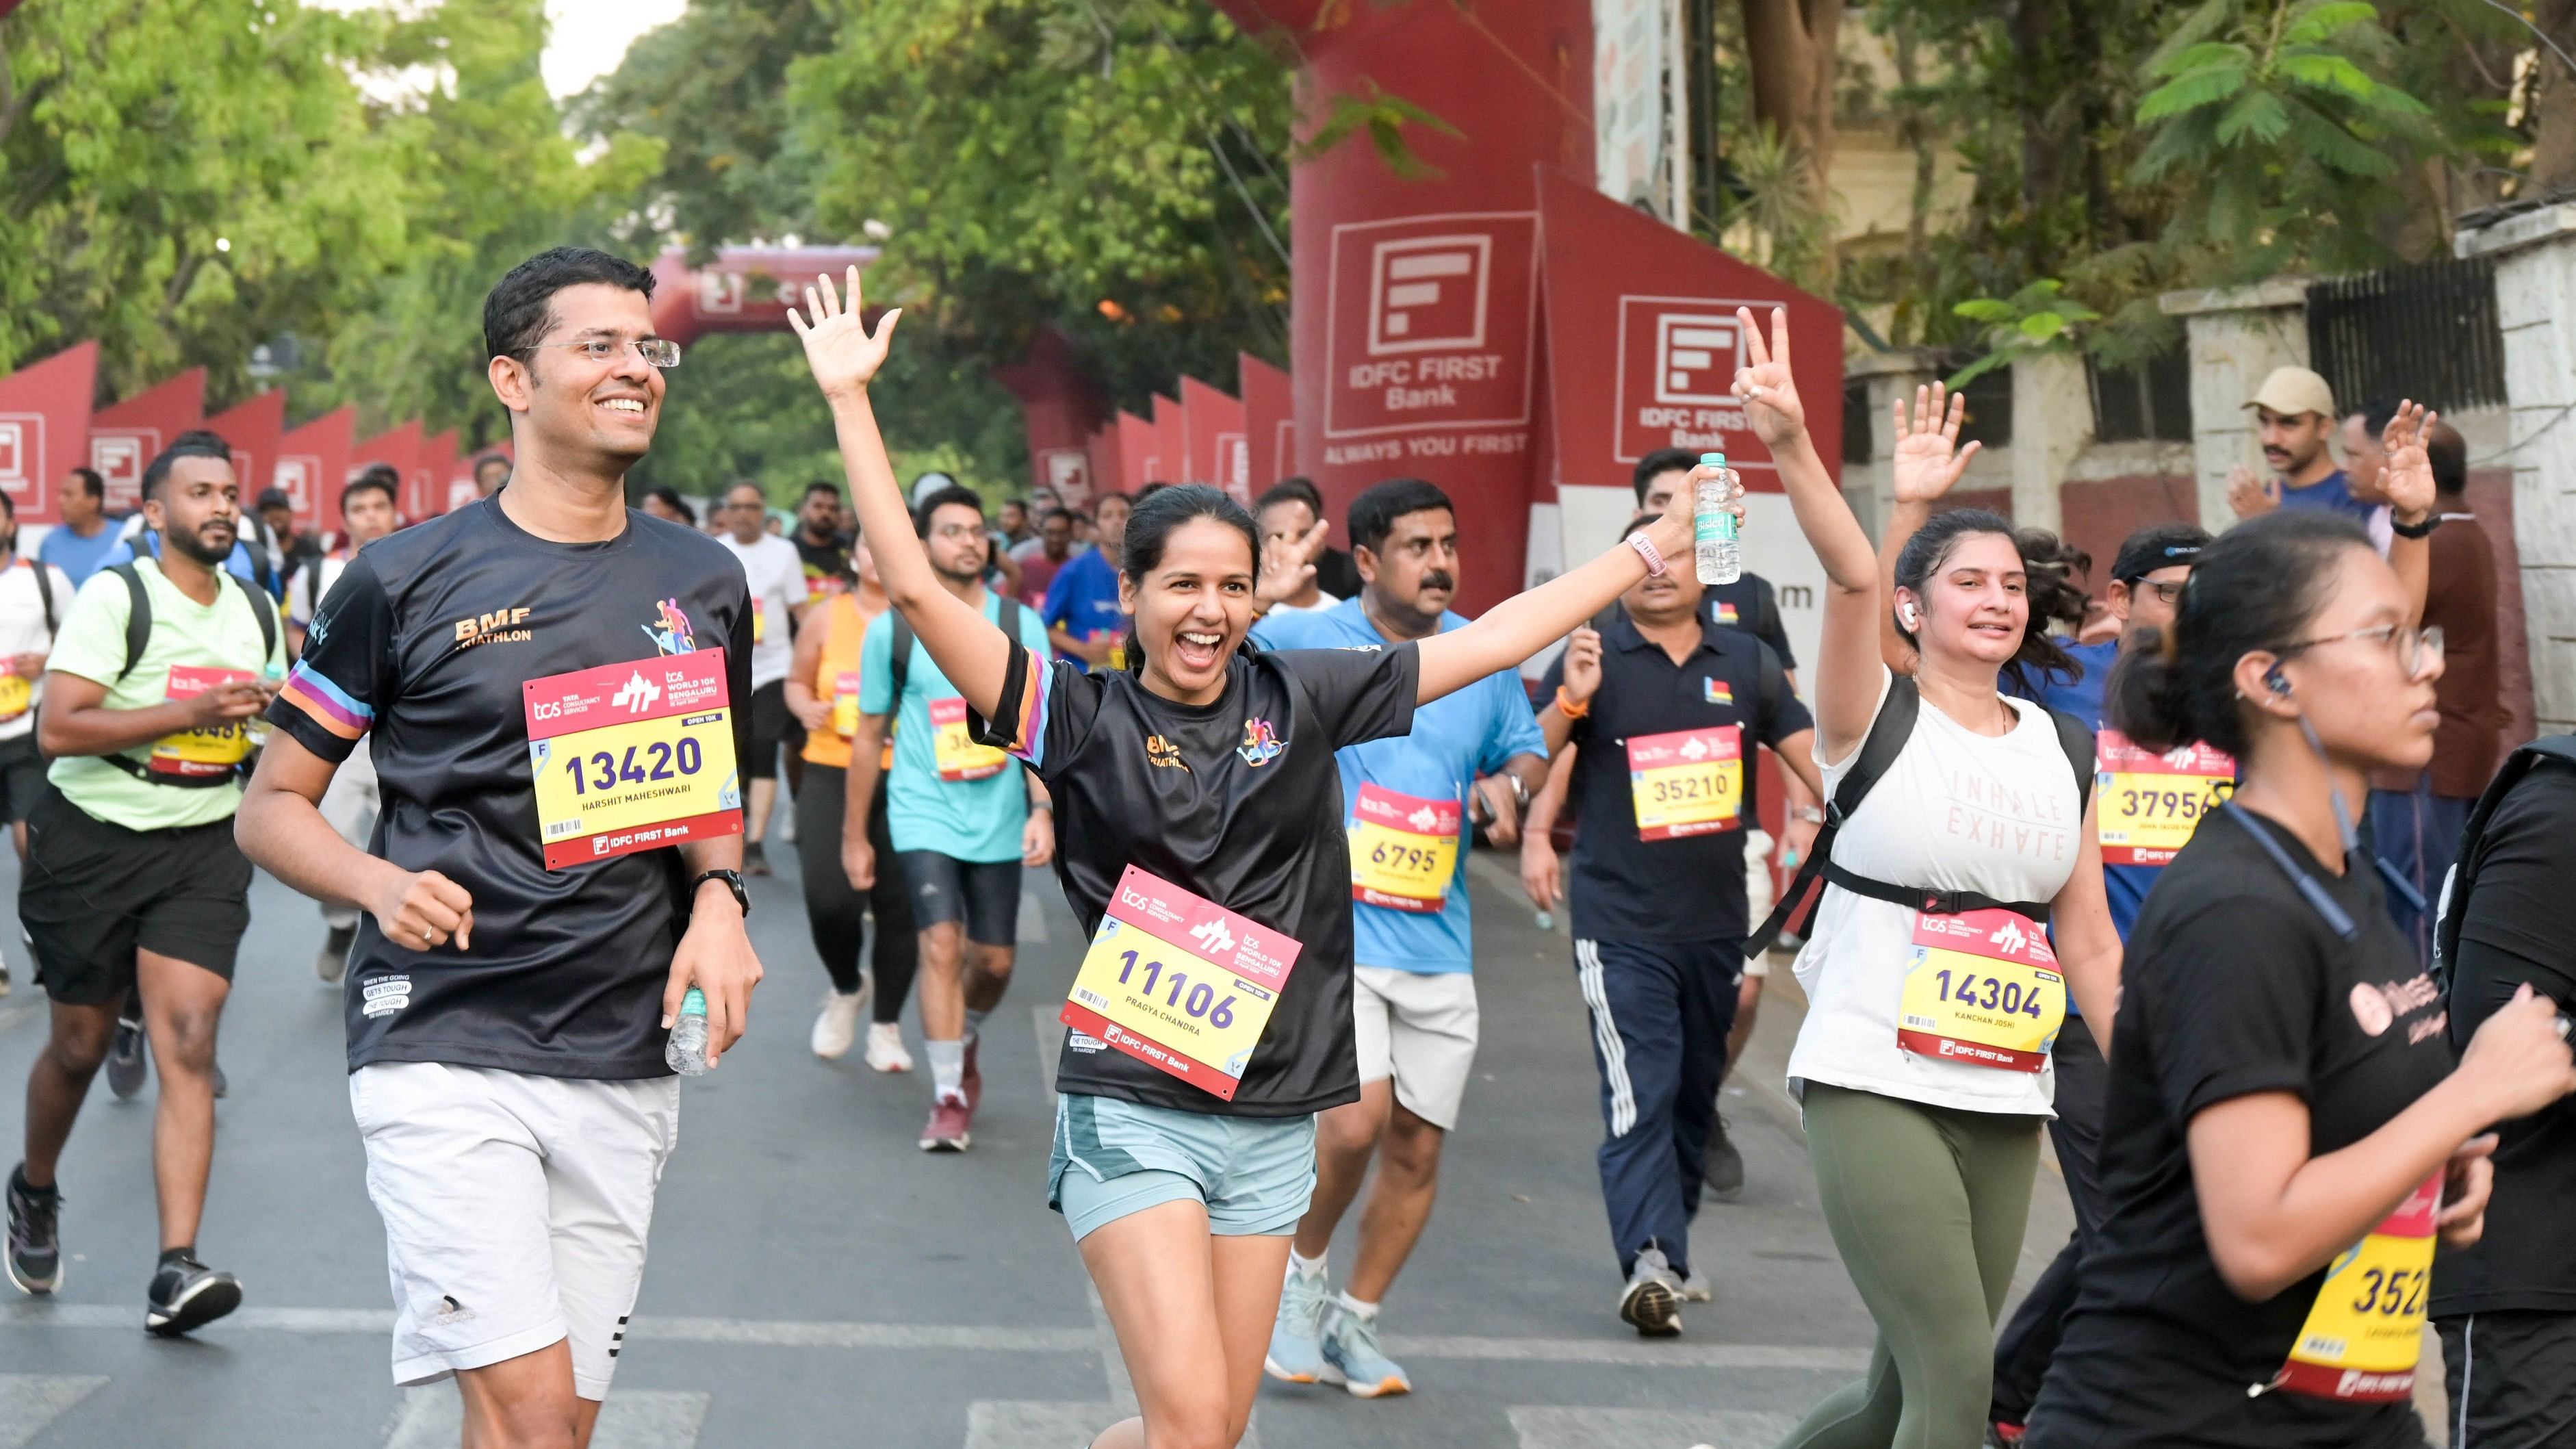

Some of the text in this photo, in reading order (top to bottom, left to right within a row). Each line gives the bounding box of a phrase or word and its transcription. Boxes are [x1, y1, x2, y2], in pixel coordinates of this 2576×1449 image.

[1350, 355, 1502, 389] IDFC FIRST
[1386, 383, 1456, 411] Bank
[1640, 407, 1691, 428] IDFC
[1324, 432, 1528, 465] ALWAYS YOU FIRST
[1671, 428, 1725, 449] Bank
[455, 607, 530, 641] BMF
[668, 677, 716, 691] WORLD 10K
[668, 685, 717, 701] BENGALURU
[563, 693, 579, 702] TATA
[563, 696, 600, 709] CONSULTANCY
[534, 702, 561, 721] tcs
[564, 705, 589, 715] SERVICES
[687, 717, 704, 725] OPEN
[538, 744, 545, 755] F
[566, 737, 701, 795] 13420
[582, 784, 691, 811] HARSHIT MAHESHWARI
[1654, 774, 1727, 802] 35210
[1953, 771, 2062, 821] INHALE
[610, 825, 689, 848] IDFC FIRST Bank
[1372, 841, 1436, 872] 6795
[1122, 886, 1148, 910] tcs
[1146, 908, 1170, 923] SERVICES
[1149, 903, 1185, 923] CONSULTANCY
[1107, 921, 1116, 930] F
[1922, 914, 1947, 933] tcs
[1243, 934, 1260, 949] tcs
[1240, 945, 1283, 969] WORLD 10K
[1917, 949, 1924, 958] F
[1236, 952, 1280, 976] BENGALURU
[363, 978, 378, 986] WHEN
[366, 984, 407, 997] GETS TOUGH
[1120, 949, 1237, 1029] 11106
[1239, 982, 1265, 998] OPEN 10K
[1936, 969, 2042, 1019] 14304
[375, 1009, 394, 1018] HARDER
[1126, 996, 1200, 1036] PRAGYA CHANDRA
[1955, 1012, 2015, 1029] KANCHAN JOSHI
[1081, 1038, 1102, 1047] TOUGH
[1120, 1035, 1189, 1073] IDFC FIRST Bank
[1955, 1045, 2014, 1063] IDFC FIRST Bank
[2354, 1269, 2427, 1315] 352
